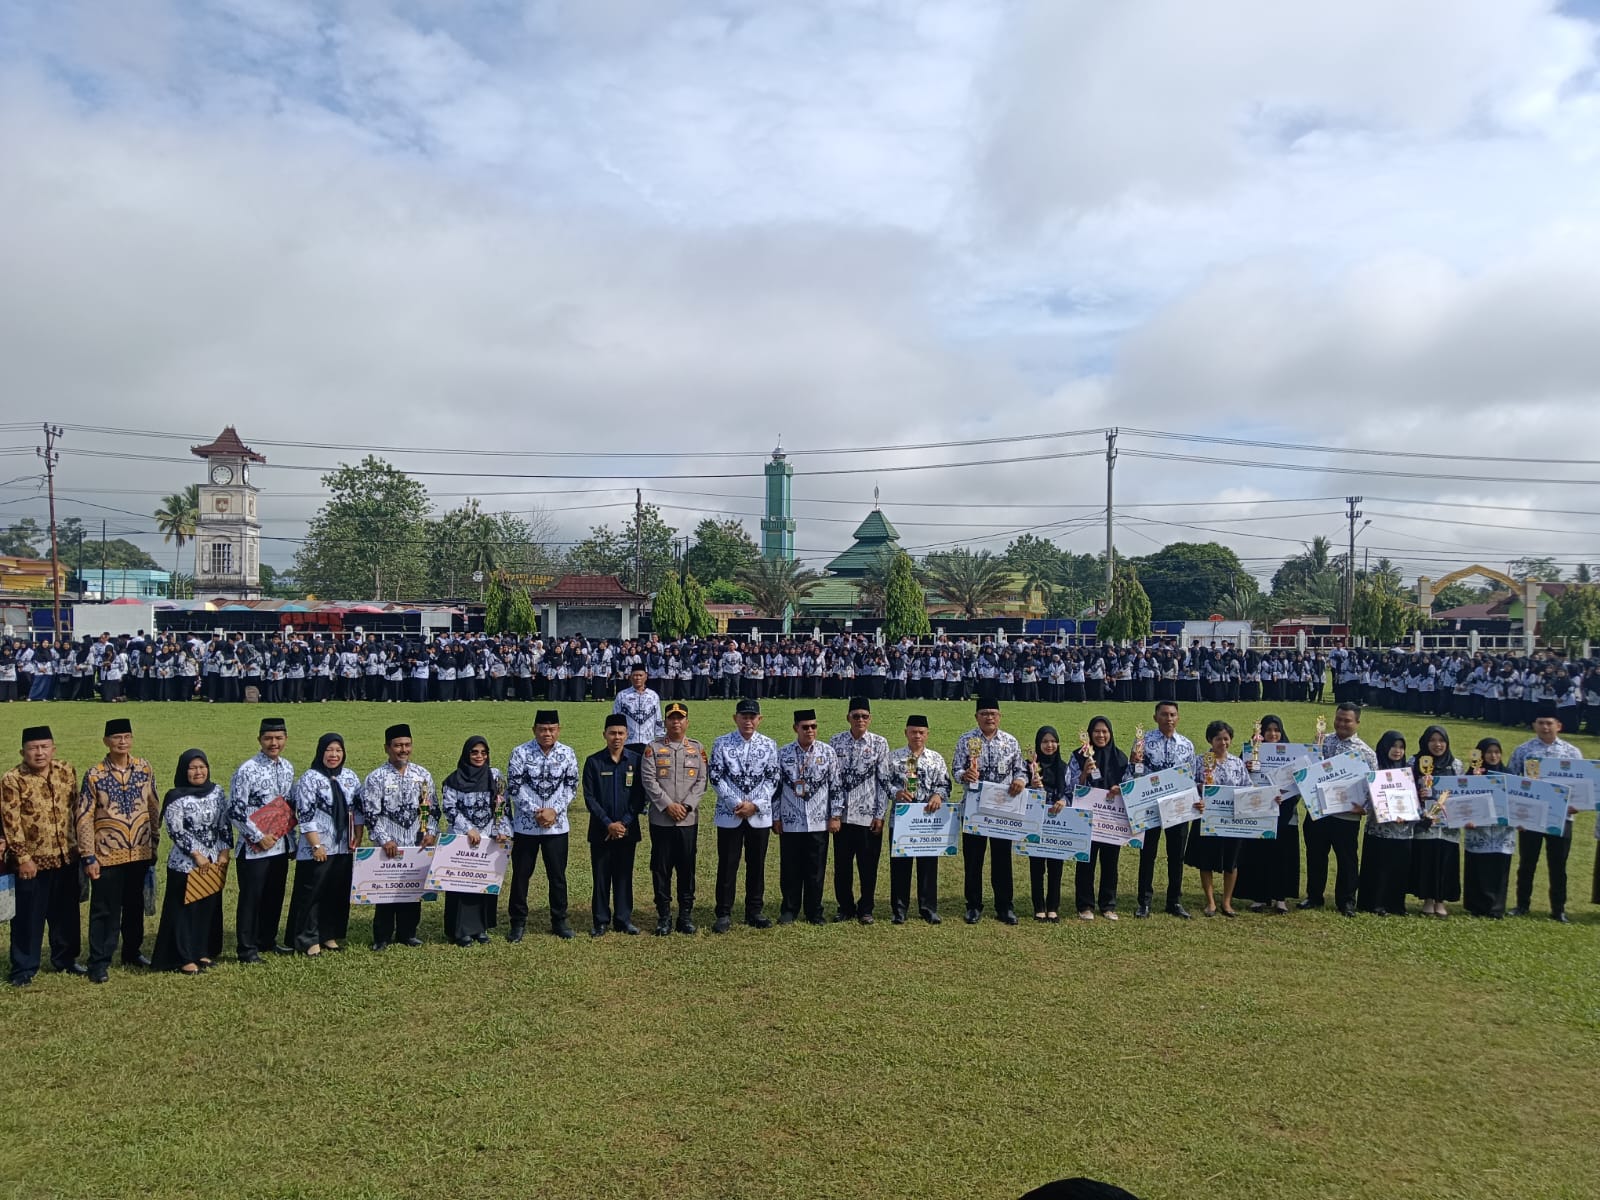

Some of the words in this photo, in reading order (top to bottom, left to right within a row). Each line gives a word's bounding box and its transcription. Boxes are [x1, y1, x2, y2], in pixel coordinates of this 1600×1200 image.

[1318, 772, 1340, 783] JUARA
[1141, 787, 1164, 798] JUARA
[1508, 790, 1534, 798] JUARA
[1093, 802, 1116, 810] JUARA
[996, 818, 1022, 828] 500.000
[458, 871, 488, 879] 1.000.000
